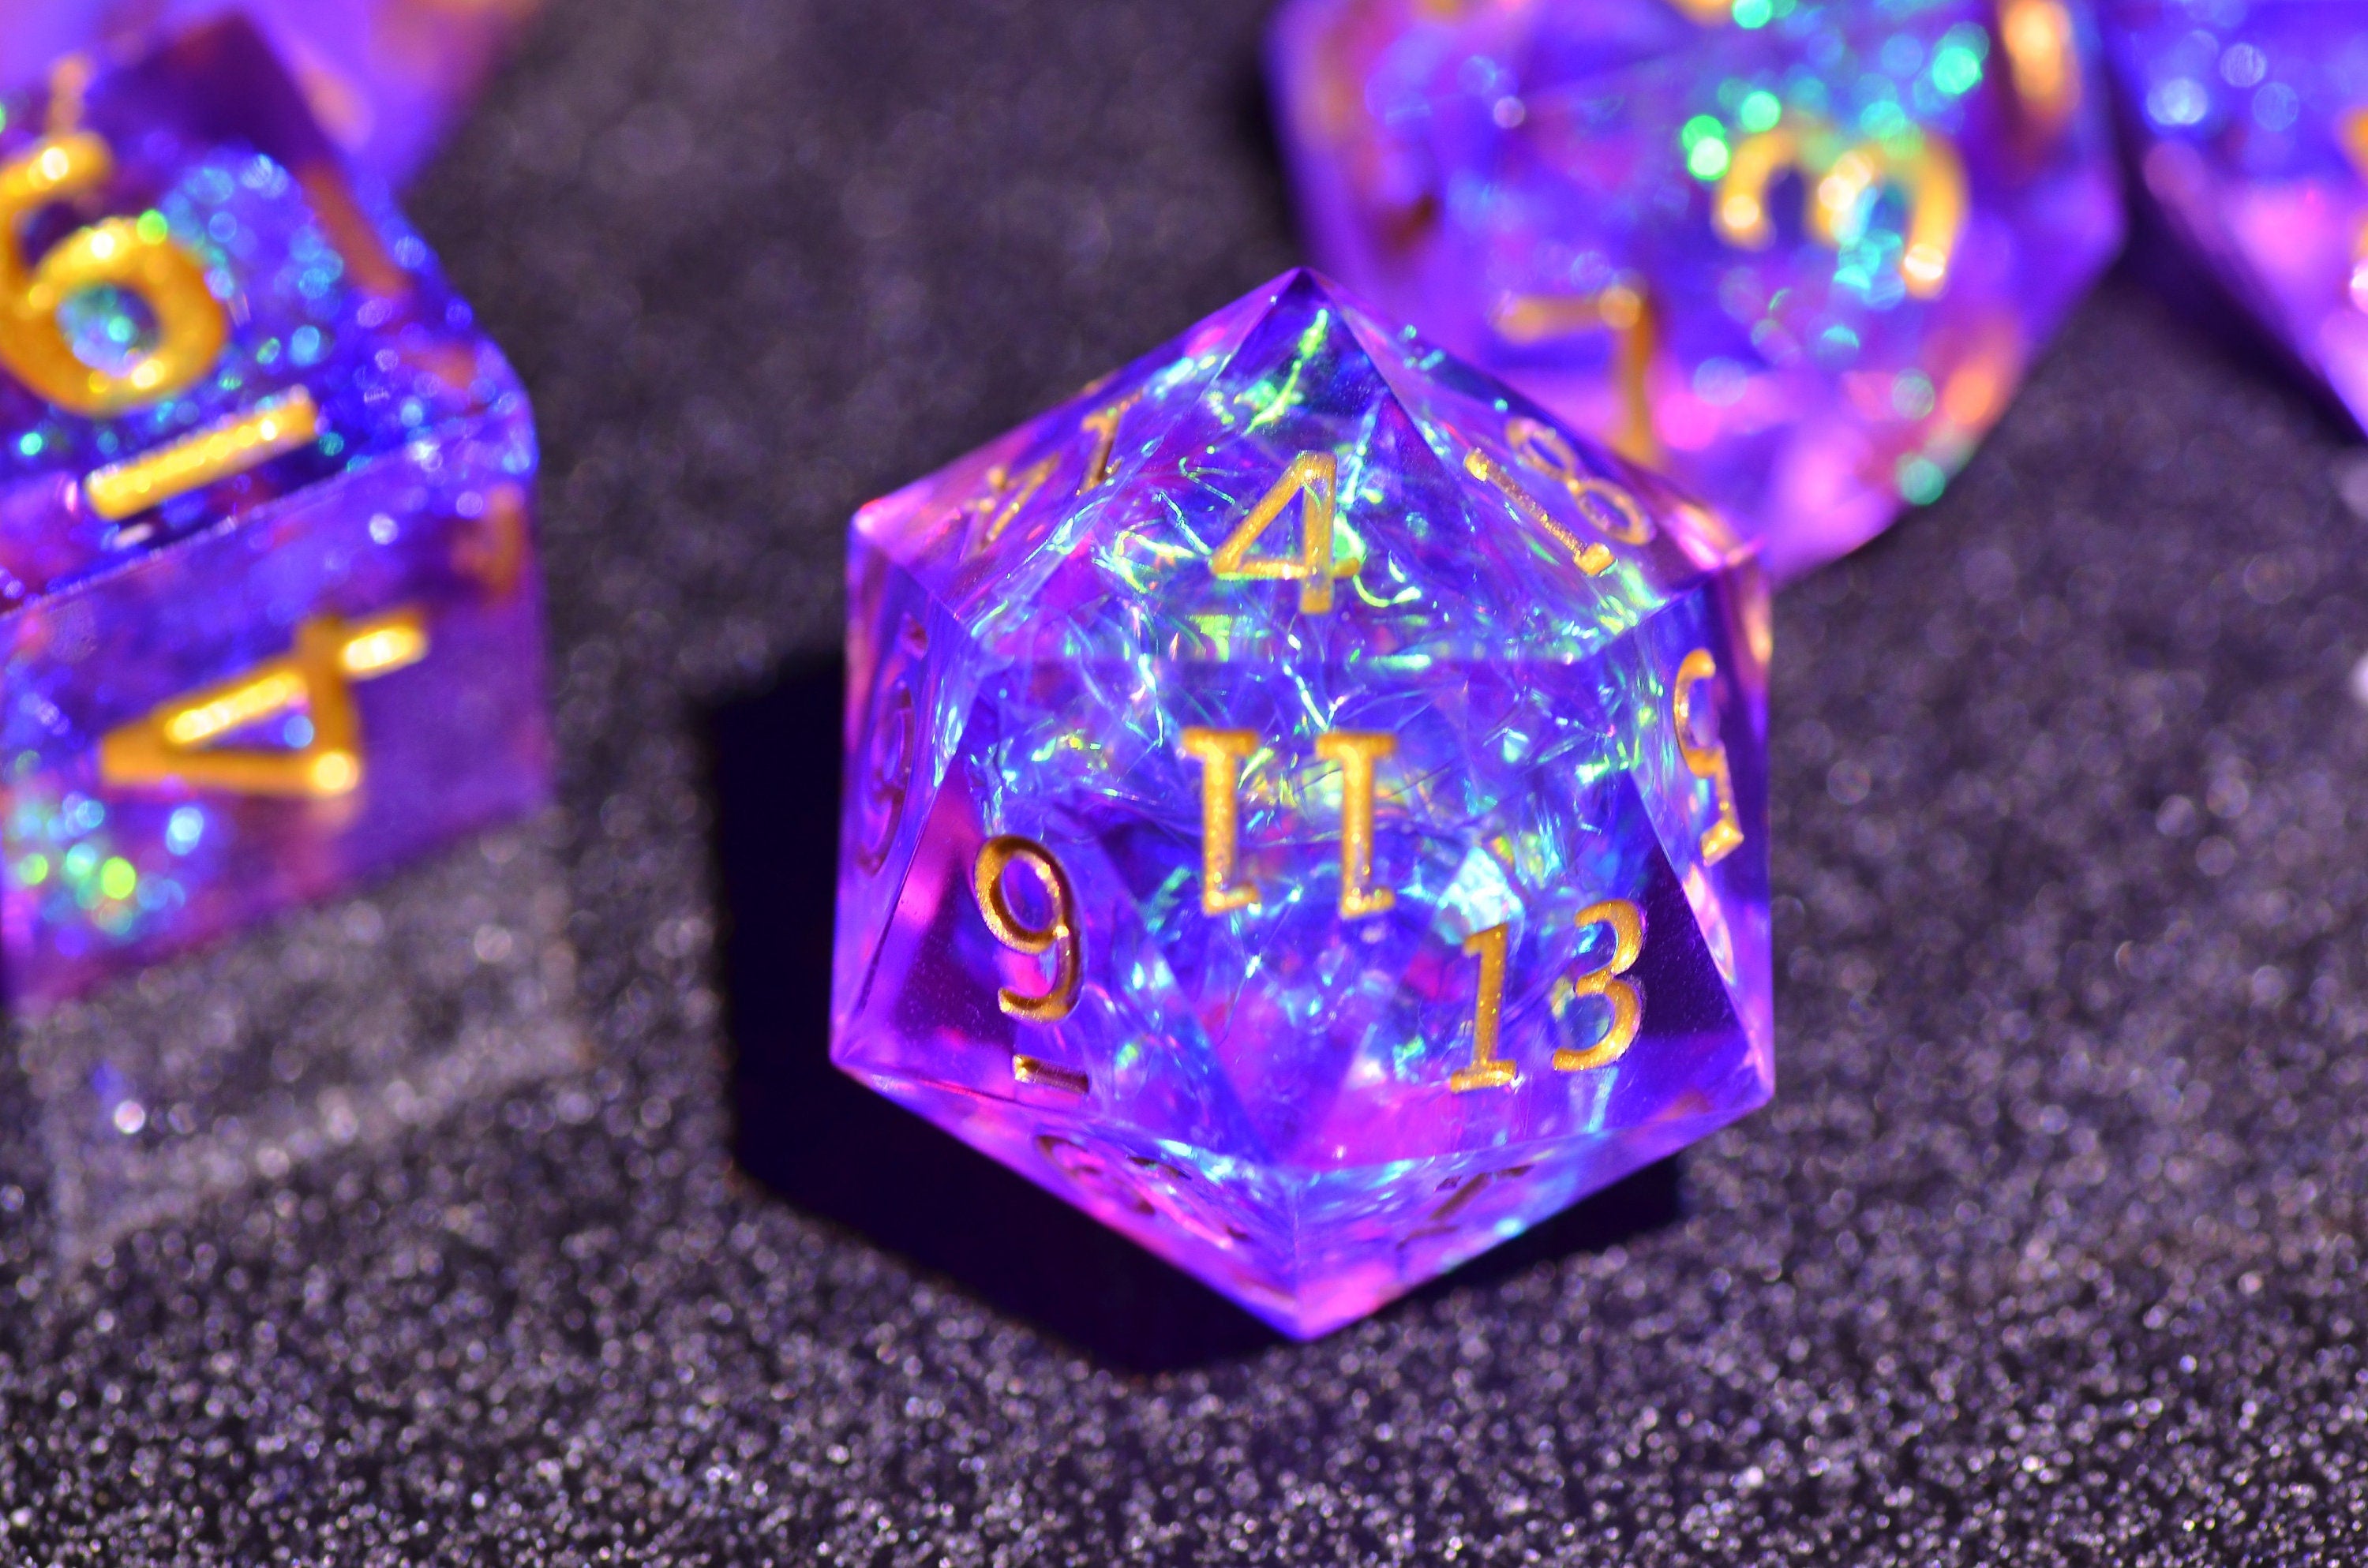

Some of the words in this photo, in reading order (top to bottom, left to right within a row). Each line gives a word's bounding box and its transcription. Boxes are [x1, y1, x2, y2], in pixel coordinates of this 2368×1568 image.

[0, 130, 229, 418] 6
[1709, 122, 1967, 300] 3
[1209, 449, 1360, 615] 4
[1463, 416, 1652, 576] 18
[99, 608, 430, 799] 4
[1182, 726, 1397, 919] 11
[974, 834, 1086, 1023] 9
[1450, 899, 1645, 1093] 13
